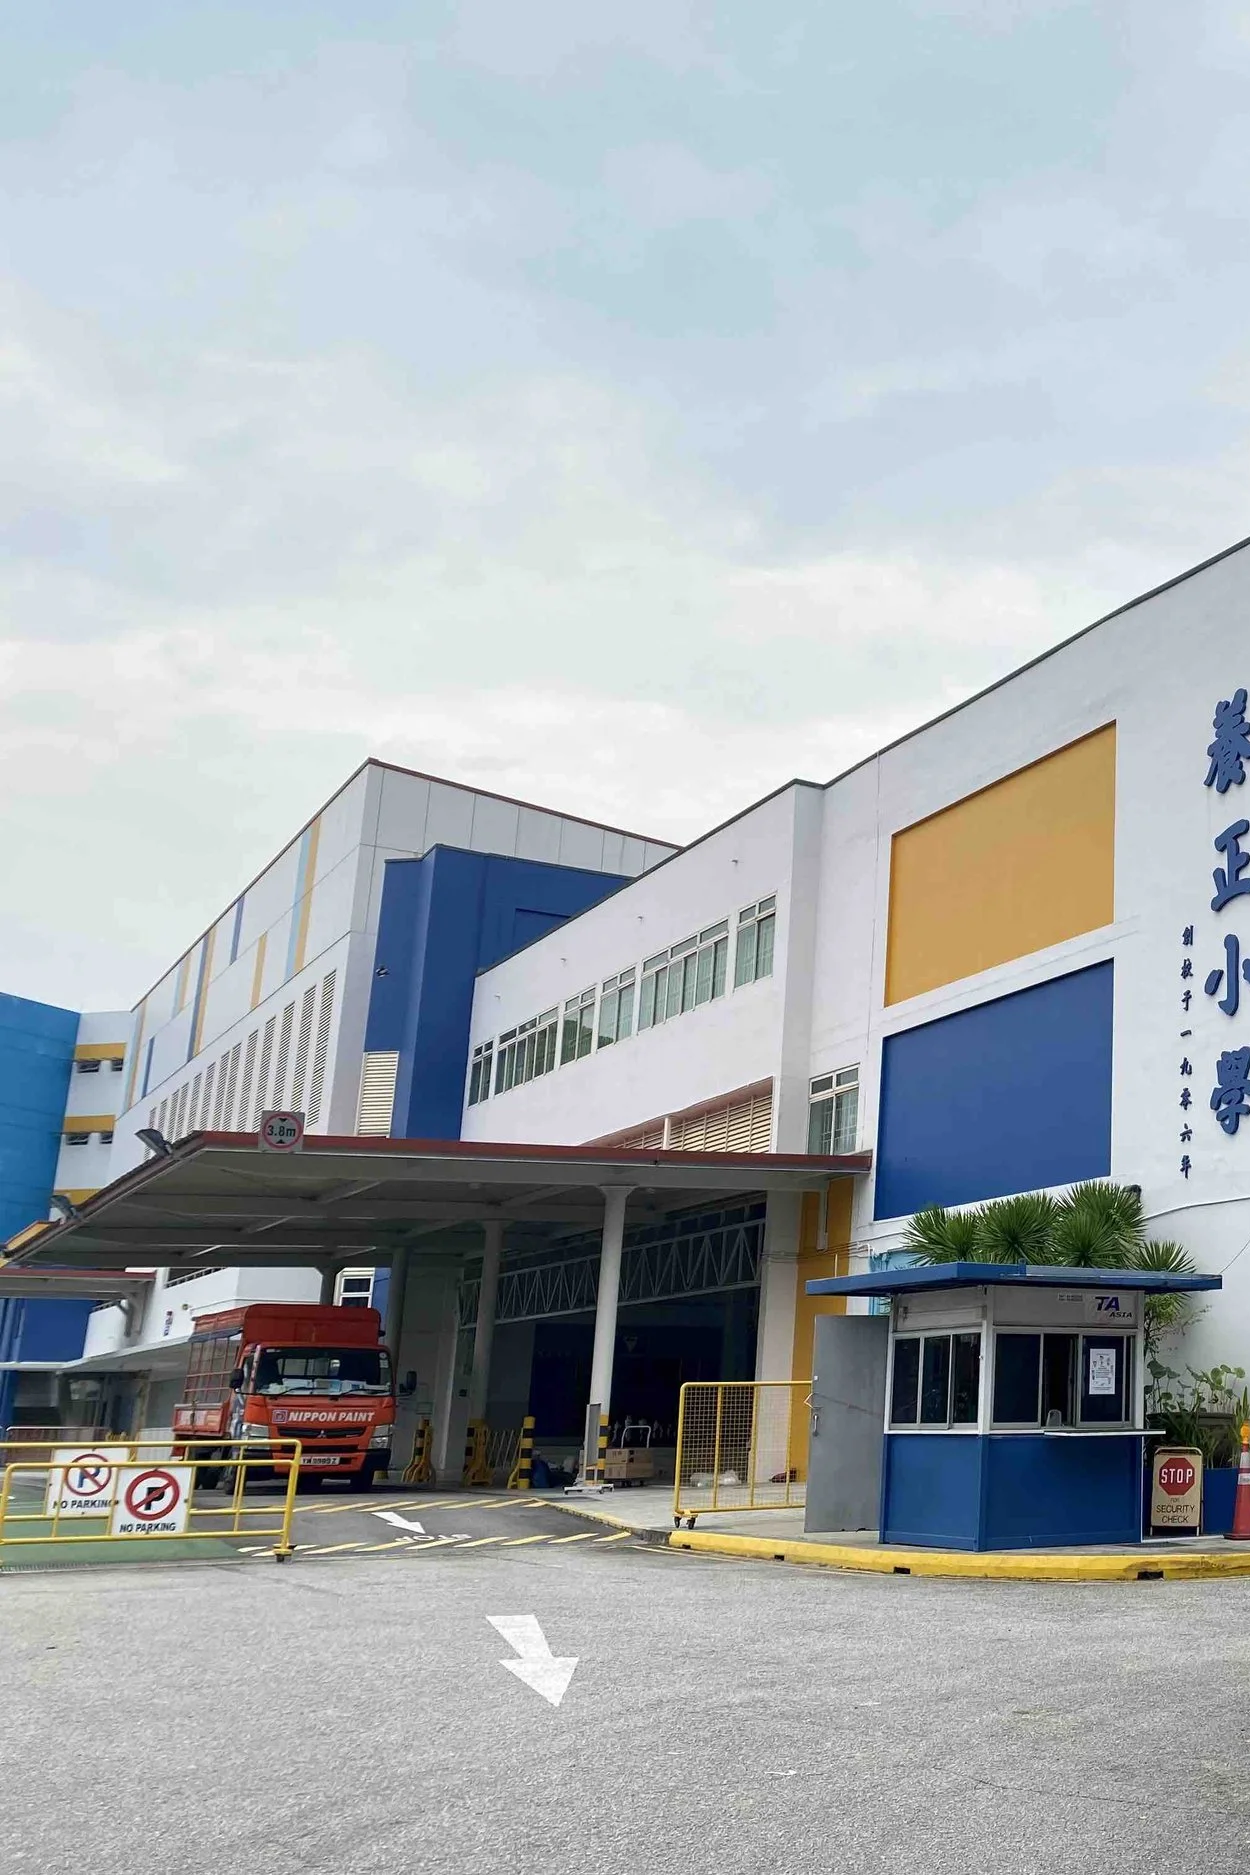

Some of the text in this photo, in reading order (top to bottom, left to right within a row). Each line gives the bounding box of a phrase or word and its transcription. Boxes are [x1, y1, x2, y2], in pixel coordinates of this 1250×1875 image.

[267, 1124, 296, 1137] 3.8m
[1094, 1296, 1120, 1311] TA
[288, 1411, 376, 1422] NIPPON PAINT
[1161, 1468, 1193, 1484] STOP
[1156, 1504, 1195, 1514] SECURITY
[1161, 1515, 1189, 1524] CHECK
[119, 1522, 176, 1533] NO PARKING
